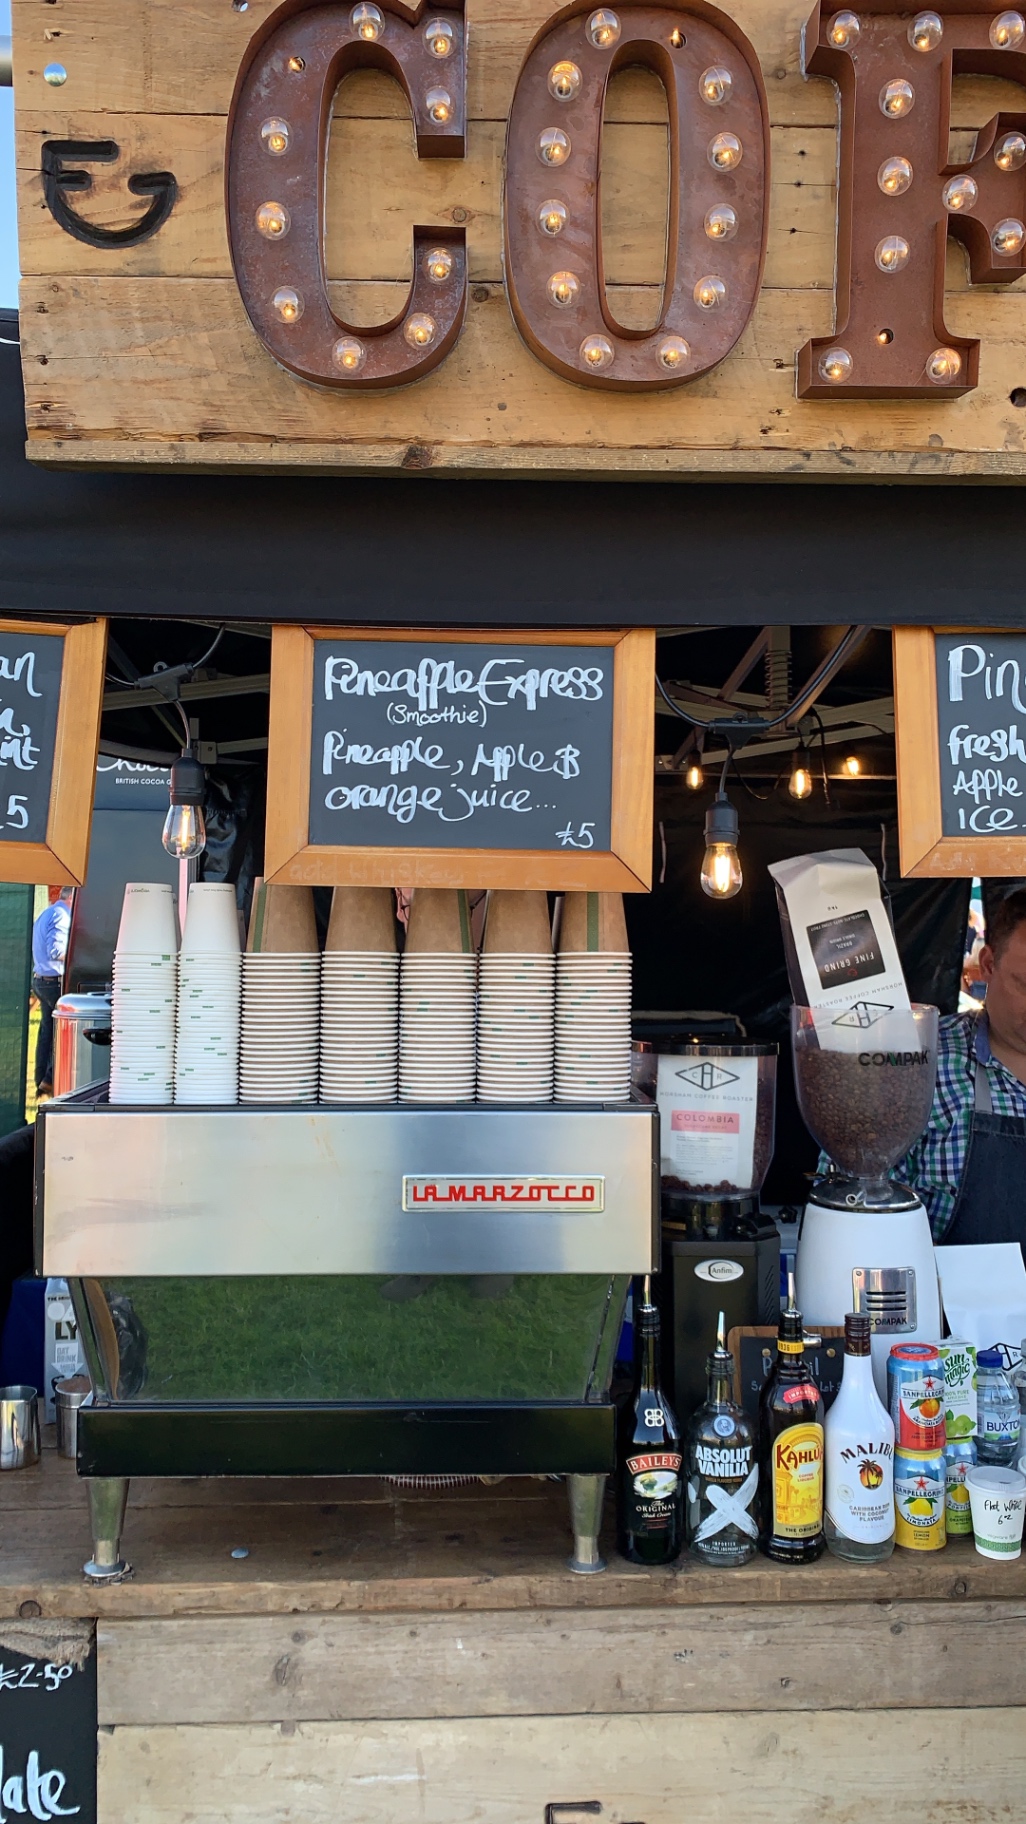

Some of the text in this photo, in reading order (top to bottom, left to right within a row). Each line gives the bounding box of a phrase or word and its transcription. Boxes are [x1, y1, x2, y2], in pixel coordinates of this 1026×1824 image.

[325, 655, 604, 711] Pineapple Express
[386, 702, 489, 728] (Smoothie)
[322, 729, 464, 775] Pineapple,
[471, 744, 554, 782] Apple
[115, 777, 139, 785] BRITISH
[952, 768, 1024, 804] Apple
[325, 784, 442, 824] orange
[555, 822, 596, 849] £5
[823, 951, 875, 973] FINE GRIND
[844, 990, 870, 1001] COFFEE
[857, 1050, 929, 1067] COMPAK
[676, 1113, 734, 1124] COLOMBIA
[629, 1454, 681, 1470] BAILEYS
[695, 1445, 753, 1463] ABSOLUT
[776, 1444, 824, 1471] KAHLÚ
[699, 1460, 749, 1477] VANILIA
[635, 1503, 676, 1513] ORIGINAL
